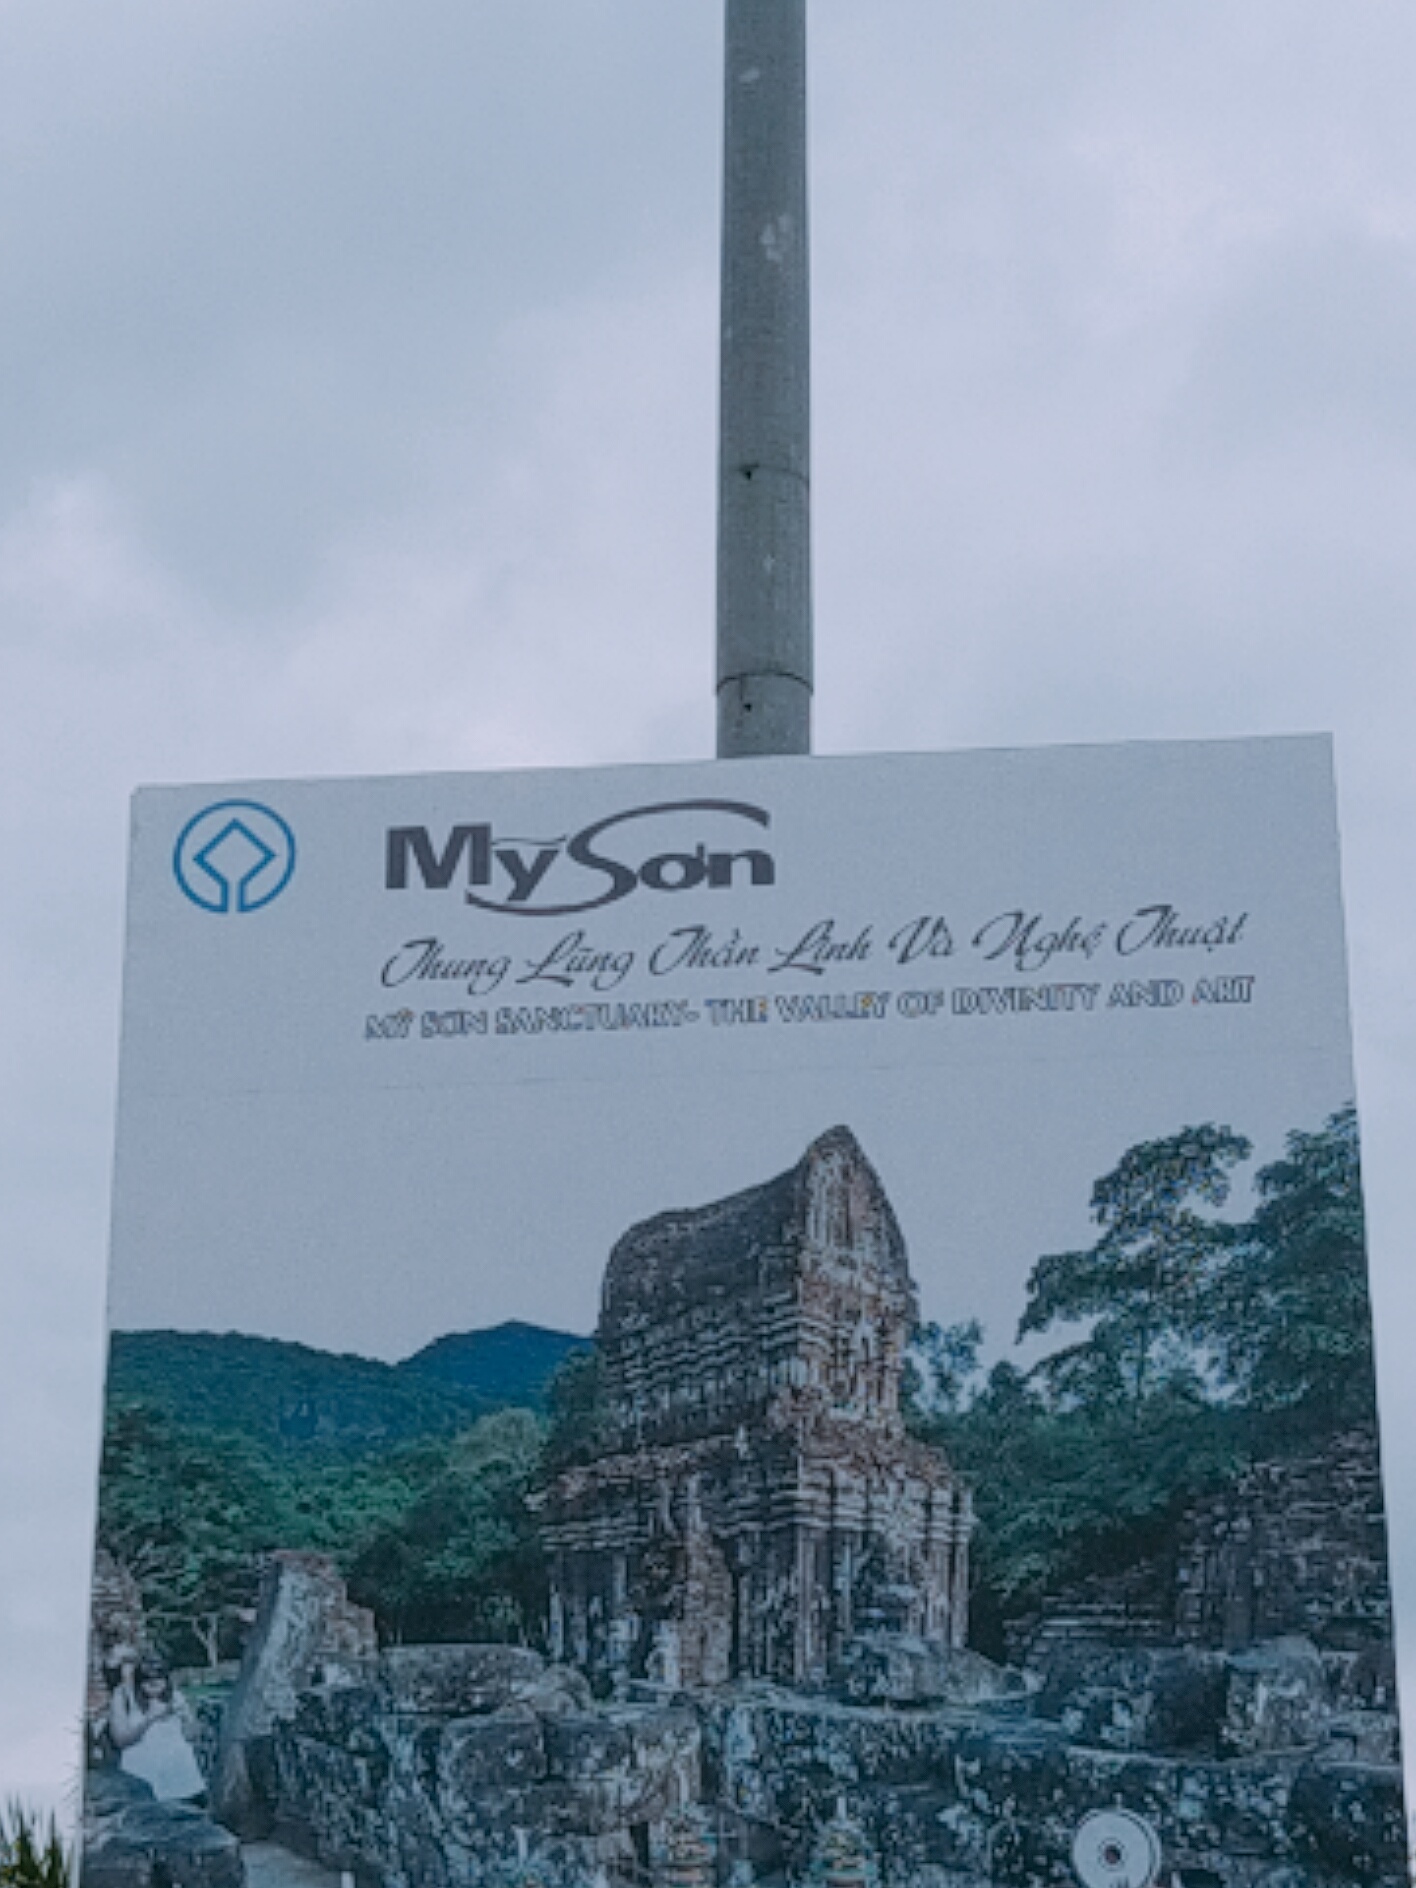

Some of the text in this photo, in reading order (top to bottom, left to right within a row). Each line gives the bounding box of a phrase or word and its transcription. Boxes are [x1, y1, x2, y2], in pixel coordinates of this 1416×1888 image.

[381, 937, 512, 995] Thung
[516, 929, 636, 991] Lũng
[768, 918, 874, 976] Linh
[888, 915, 955, 965] Và
[704, 996, 769, 1024] THE
[774, 991, 891, 1022] VALLEY
[897, 988, 945, 1019] OF
[952, 983, 1100, 1016] DIVINITY
[1107, 979, 1184, 1008] AND
[1192, 975, 1256, 1005] ART
